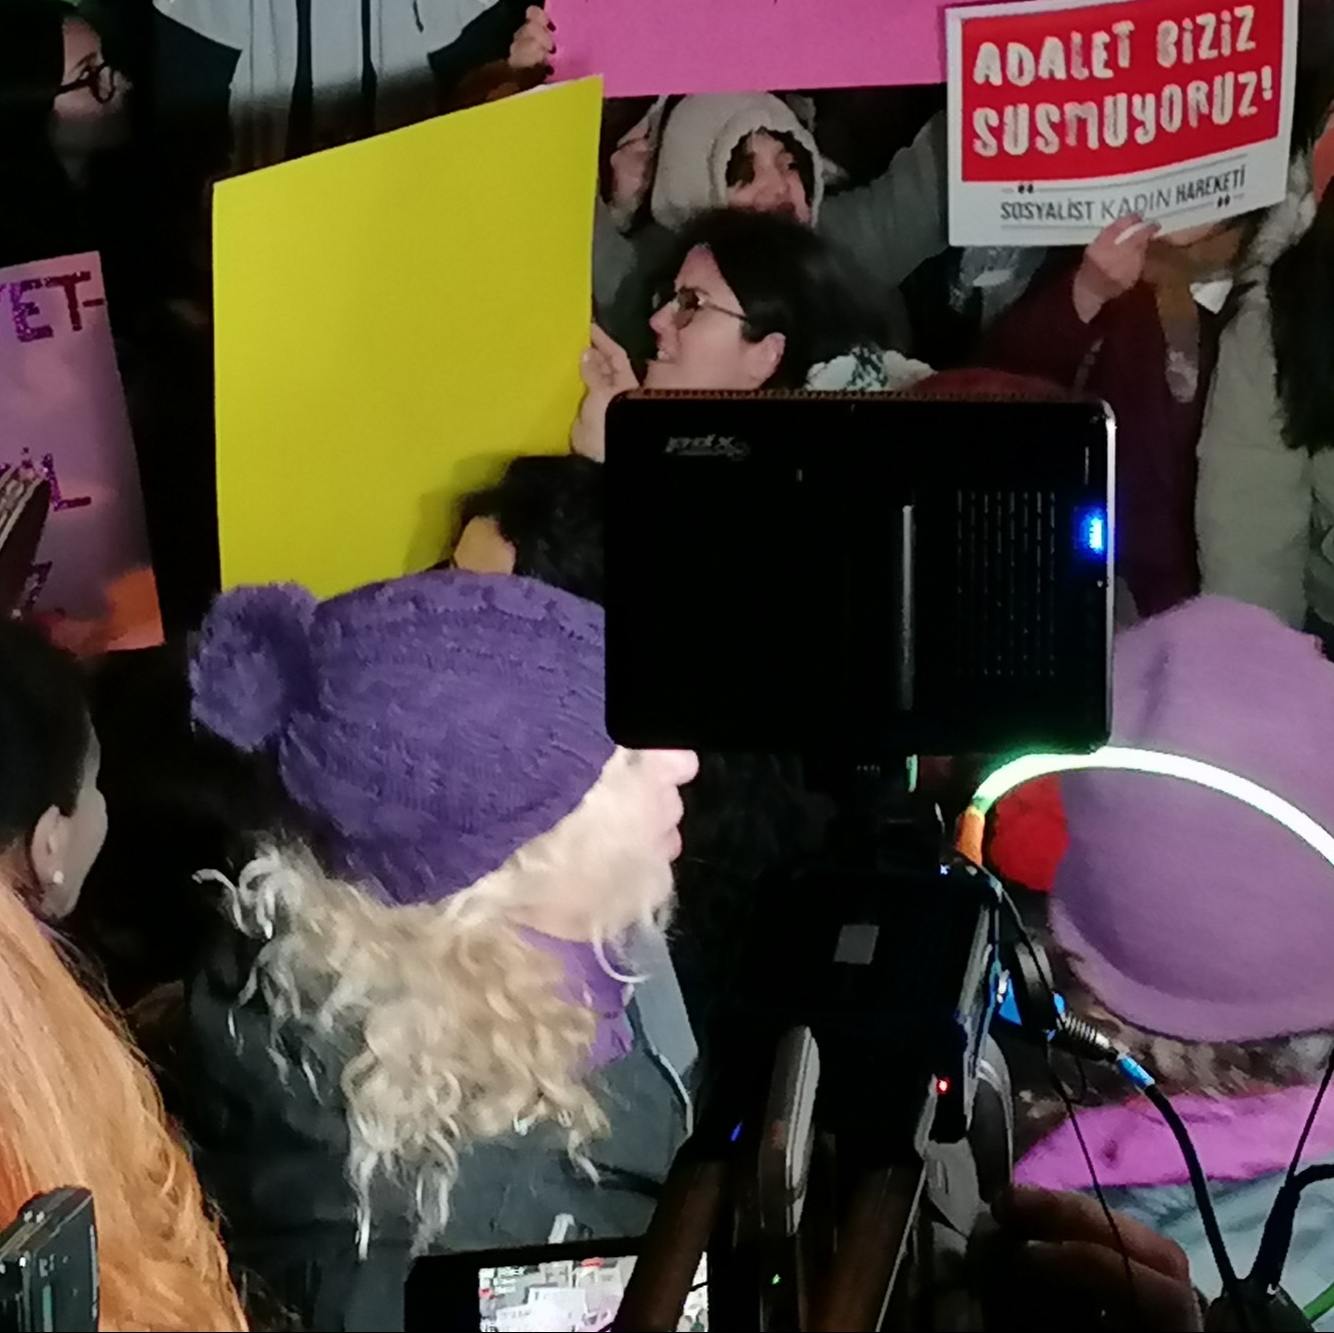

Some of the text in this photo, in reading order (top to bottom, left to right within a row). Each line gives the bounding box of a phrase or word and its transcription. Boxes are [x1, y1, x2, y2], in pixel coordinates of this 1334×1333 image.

[973, 4, 1256, 87] ADALET BİZİZ
[972, 65, 1273, 158] SUSMUYORUZ!
[1000, 164, 1246, 222] SOSYALİST KADIN HAREKETİ
